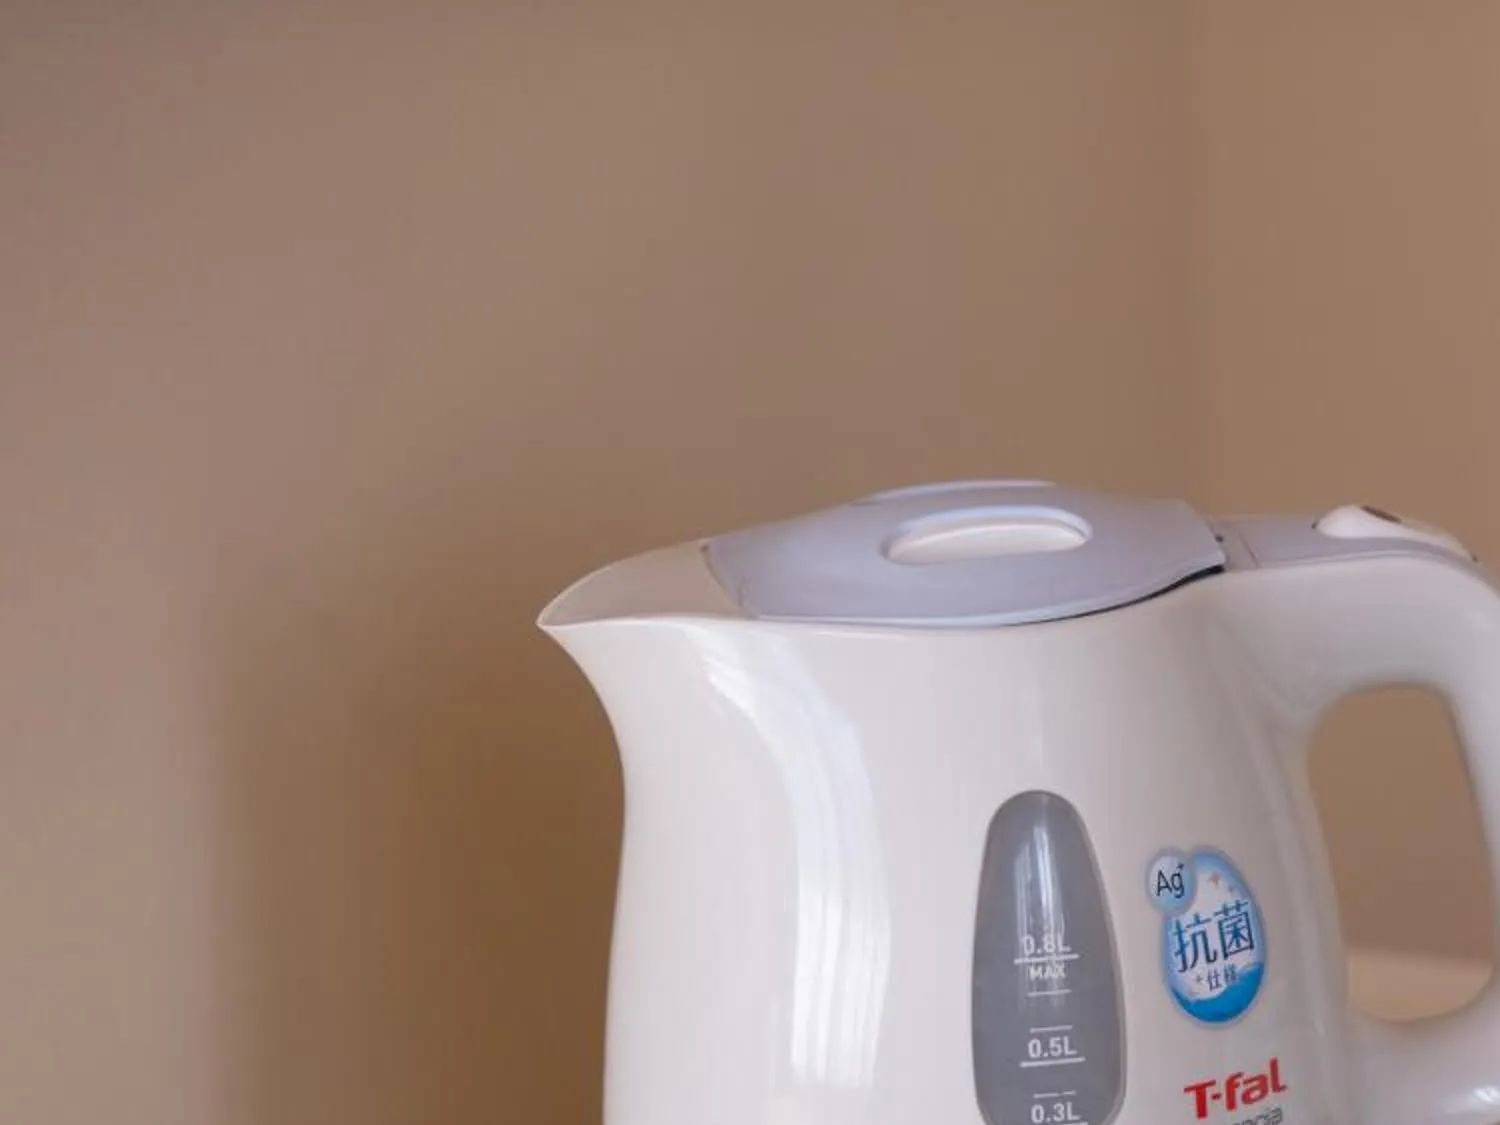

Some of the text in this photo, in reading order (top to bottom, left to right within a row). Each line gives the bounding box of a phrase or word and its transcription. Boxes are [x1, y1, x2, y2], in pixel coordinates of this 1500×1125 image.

[1022, 932, 1072, 957] 0.8L
[1173, 900, 1255, 973] 抗菌
[1029, 964, 1067, 980] MAX
[1027, 1035, 1078, 1058] 0.5L
[1183, 1055, 1288, 1120] T-fal
[1030, 1101, 1082, 1124] 0.3L
